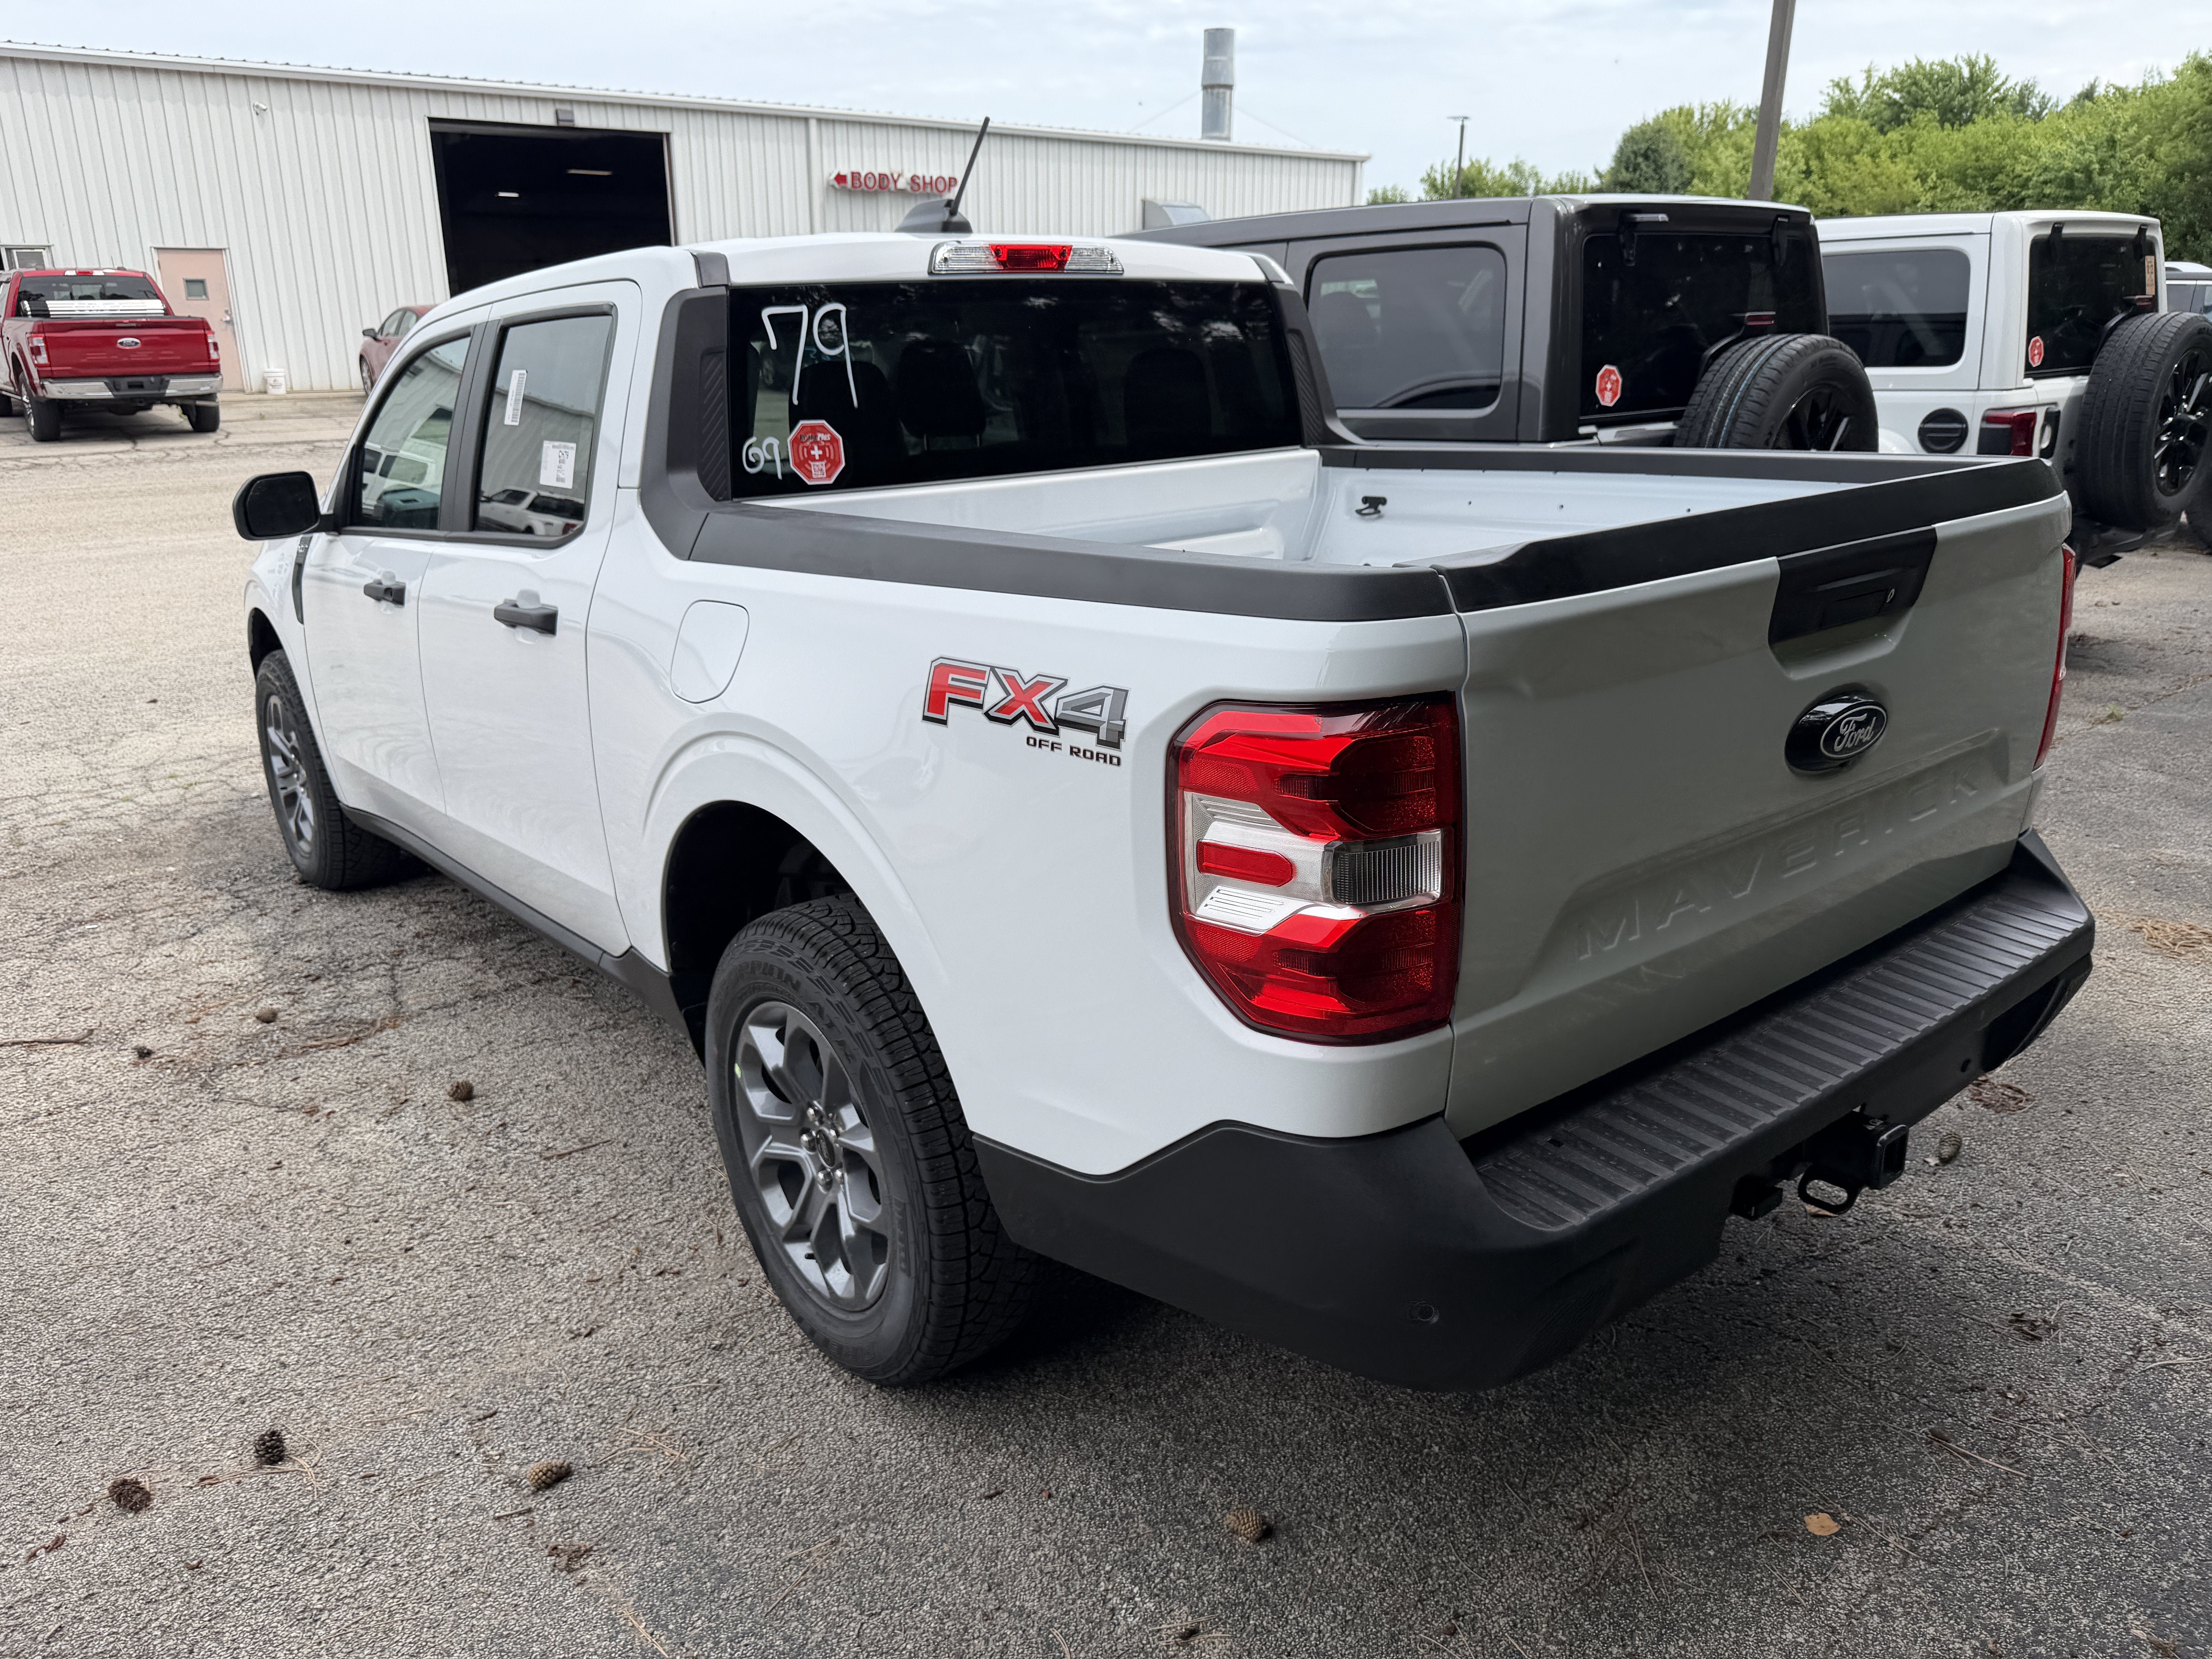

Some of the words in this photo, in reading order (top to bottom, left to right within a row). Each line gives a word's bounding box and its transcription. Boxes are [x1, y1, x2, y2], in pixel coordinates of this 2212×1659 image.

[850, 172, 901, 191] BODY
[910, 174, 957, 194] SHOP
[761, 302, 858, 409] 79
[922, 656, 1129, 750] FX4
[1834, 713, 1876, 748] Ford
[1026, 735, 1062, 751] OFF
[1070, 745, 1121, 766] ROAD
[1575, 769, 1979, 961] MAVERICK
